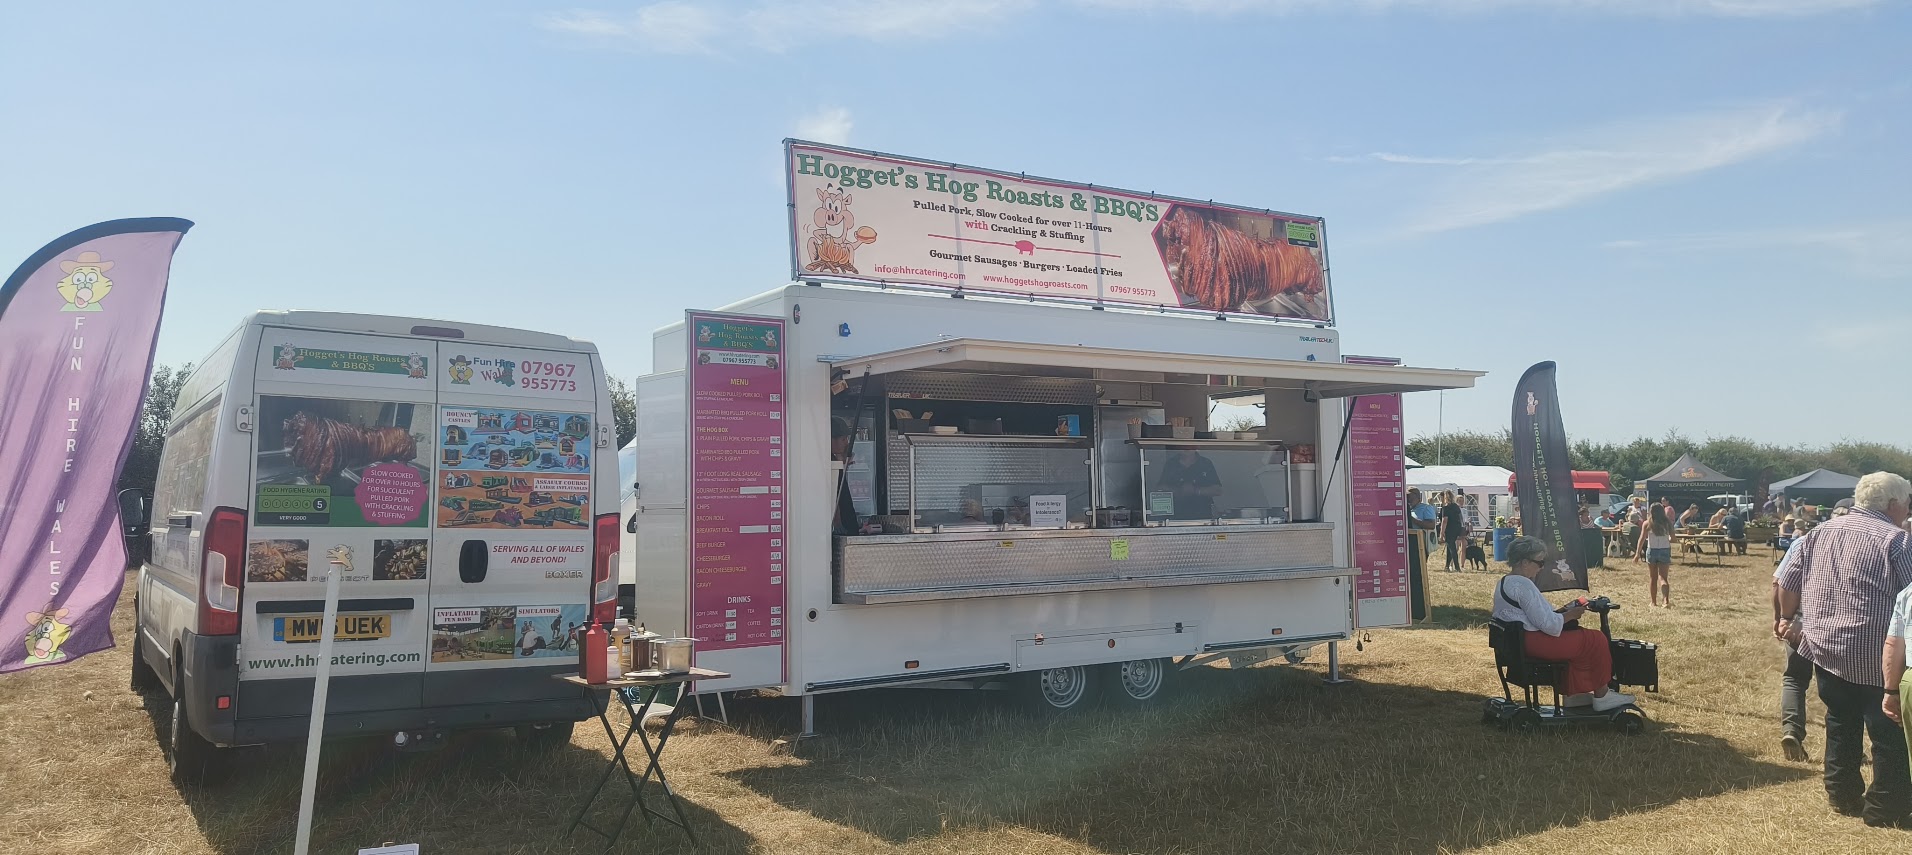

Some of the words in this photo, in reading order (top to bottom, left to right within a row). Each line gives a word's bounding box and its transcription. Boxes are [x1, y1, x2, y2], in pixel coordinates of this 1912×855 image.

[797, 154, 918, 189] Hogget's
[924, 172, 979, 202] Hog
[986, 180, 1064, 208] Roasts
[1070, 192, 1087, 212] &
[1093, 196, 1159, 222] BBQ'S
[913, 200, 946, 212] Pulled
[948, 205, 974, 218] Pork,
[976, 208, 997, 220] Slow
[999, 212, 1034, 224] Cooked
[1036, 216, 1050, 226] for
[1052, 220, 1072, 228] over
[1074, 220, 1112, 232] 11-Hours
[965, 220, 989, 230] with
[991, 224, 1037, 238] Crackling
[1050, 230, 1085, 242] Stuffing
[930, 250, 972, 262] Gourmet
[974, 254, 1018, 268] Sausages
[1023, 260, 1060, 272] Burgers
[1066, 264, 1098, 274] Loaded
[1100, 268, 1122, 277] Fries
[874, 264, 966, 280] info@hhrcatering.com
[983, 274, 1088, 290] www.hoggetshogroasts.com
[1110, 286, 1131, 294] 07967
[1132, 287, 1156, 297] 955773
[71, 316, 86, 371] FUN
[300, 349, 345, 360] Hogget's
[348, 352, 368, 362] Hog
[372, 354, 406, 363] Roasts
[342, 362, 375, 370] BBQ'S
[474, 358, 492, 366] Fun
[495, 359, 516, 368] Hire
[522, 360, 576, 377] 07967
[522, 378, 577, 392] 955773
[64, 397, 80, 473] HIRE
[378, 487, 414, 495] SUCCULENT
[1533, 422, 1545, 465] HOGGETS
[1540, 467, 1549, 487] HOG
[1545, 489, 1555, 518] ROAST
[1553, 529, 1564, 552] BBQS
[381, 504, 414, 512] CRACKLING
[50, 498, 66, 597] WALES
[344, 617, 383, 634] UEK
